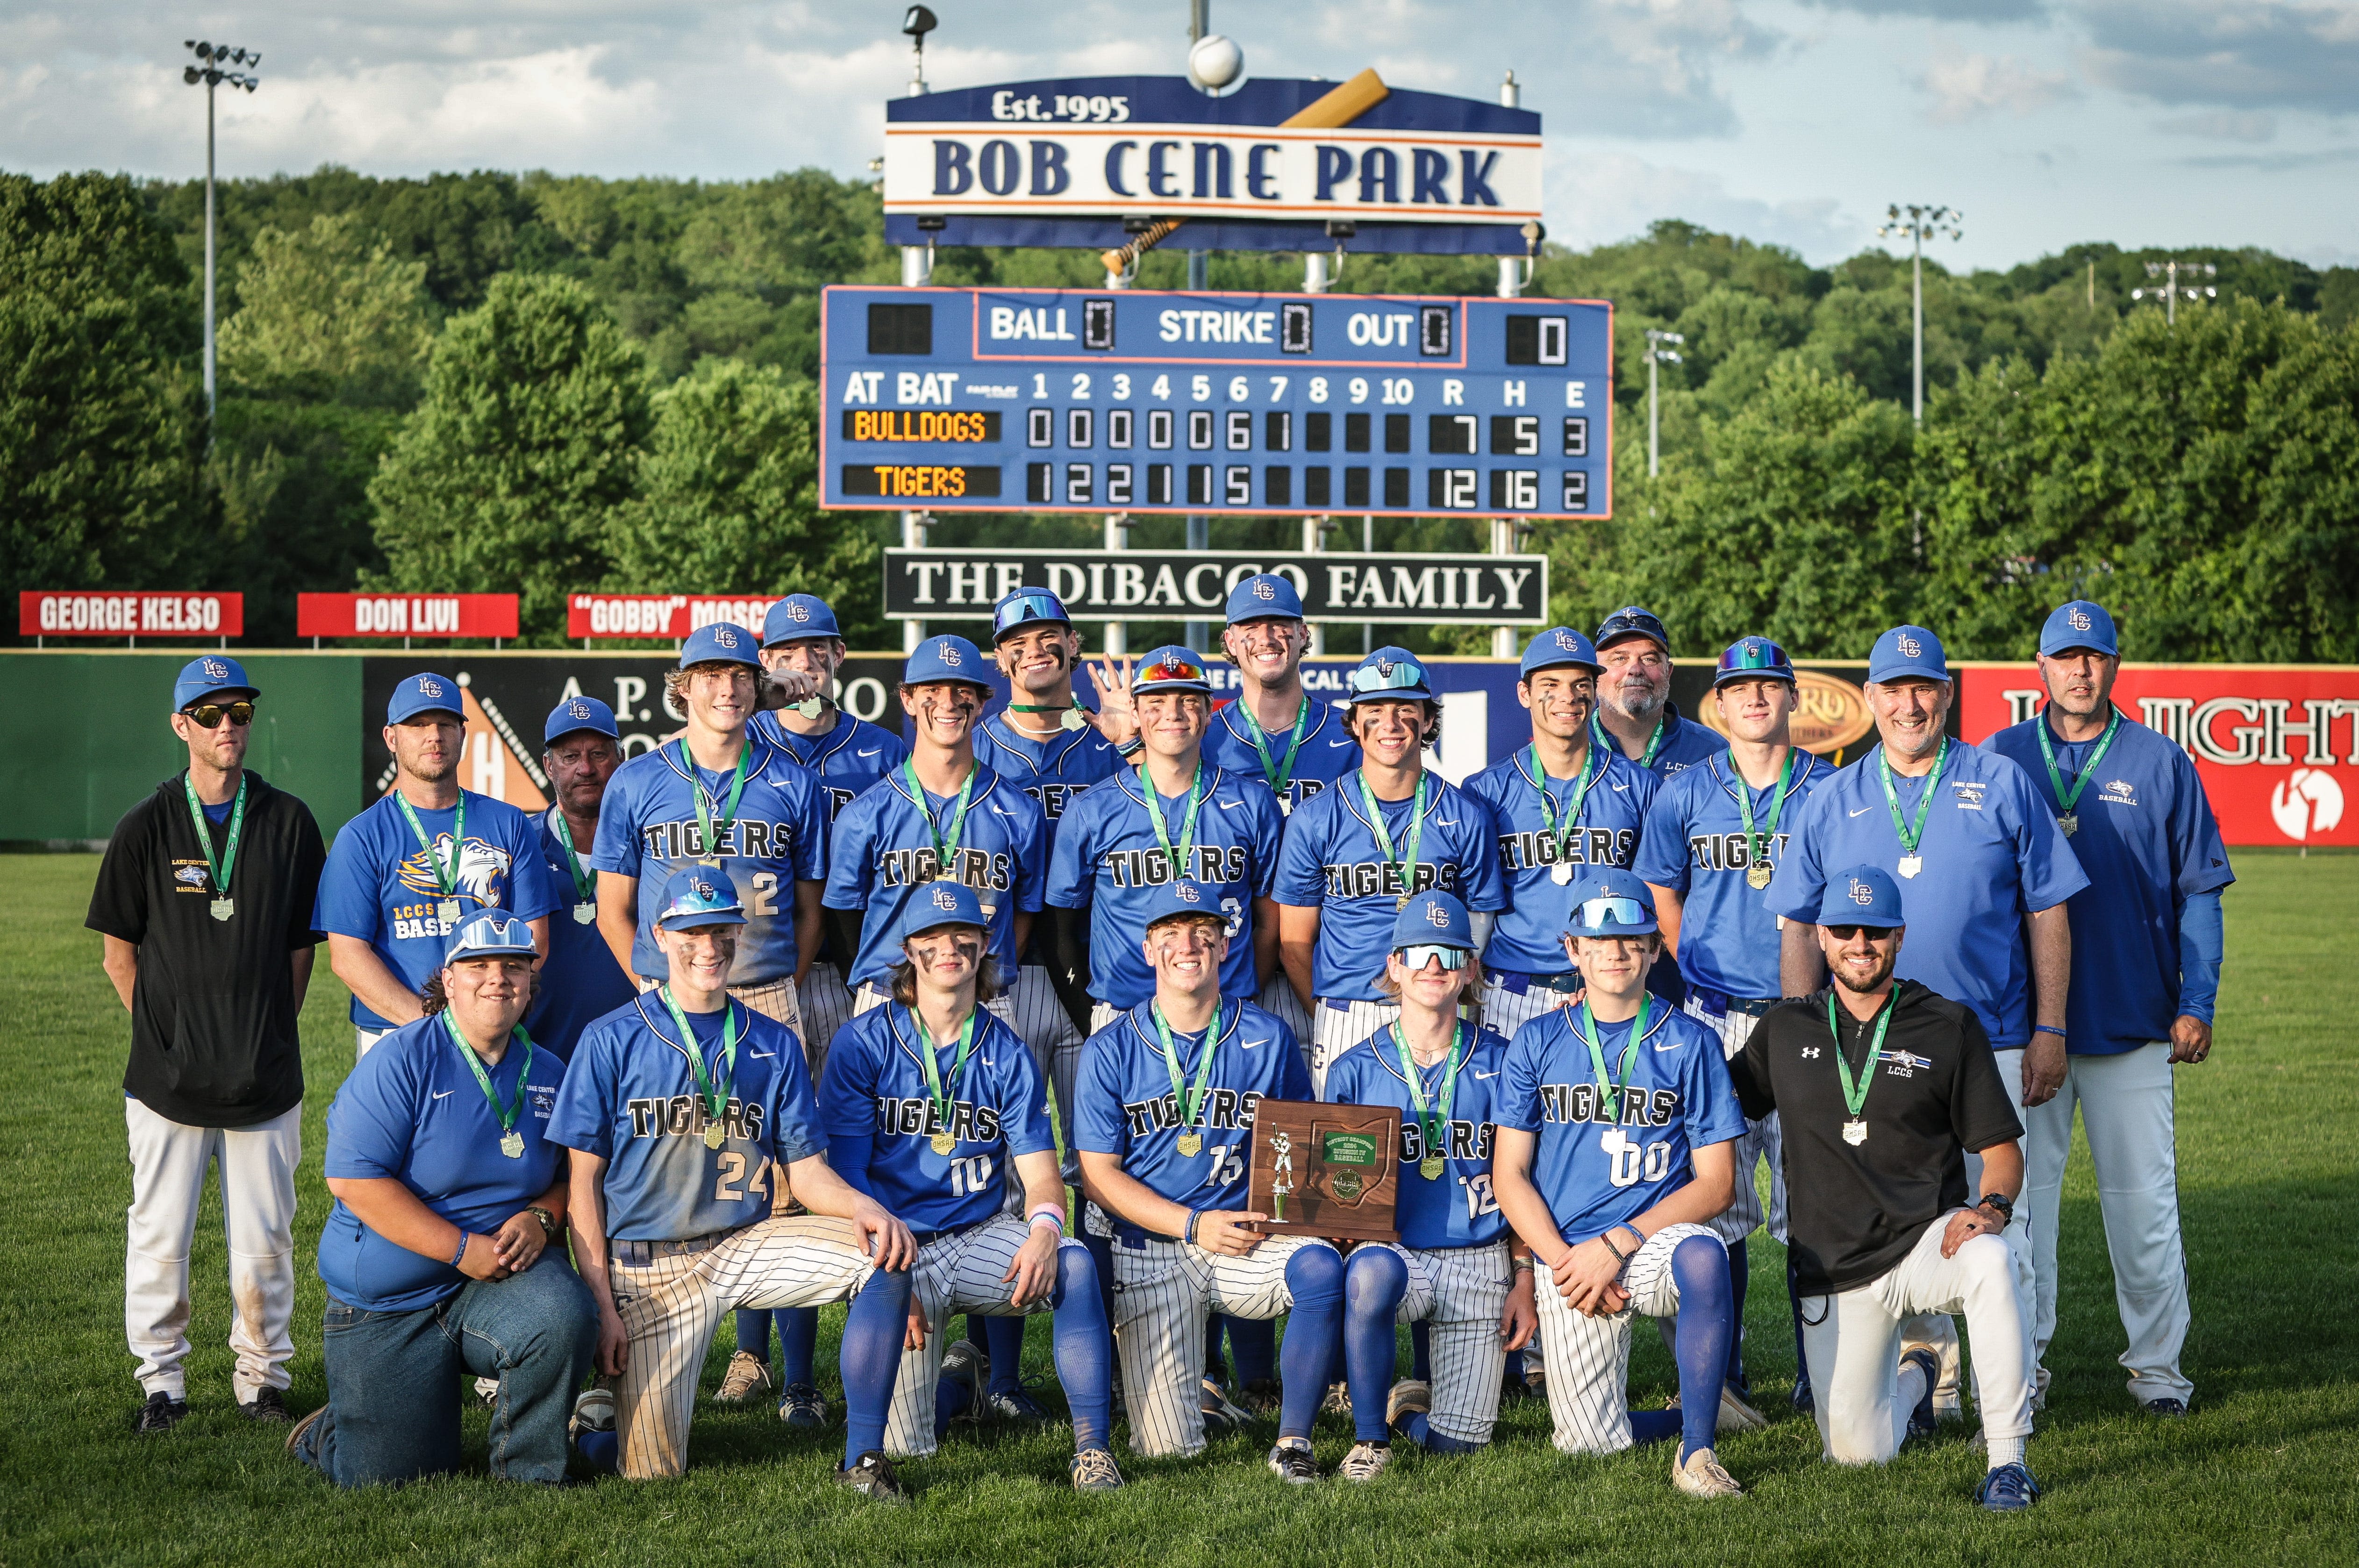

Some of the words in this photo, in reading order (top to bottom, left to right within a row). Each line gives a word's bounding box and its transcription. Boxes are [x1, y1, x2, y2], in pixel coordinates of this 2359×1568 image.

[992, 90, 1053, 121] Est.
[1054, 95, 1130, 122] 1995
[932, 140, 1070, 196] BOB
[1106, 141, 1281, 200] CENE
[1315, 144, 1504, 207] PARK
[990, 307, 1076, 341] BALL
[1159, 309, 1275, 344] STRIKE
[1347, 313, 1414, 347] OUT
[1538, 317, 1567, 365] 0
[844, 372, 885, 404] AT
[897, 372, 959, 405] BAT
[1033, 374, 1048, 399] 1
[1072, 374, 1091, 399] 2
[1112, 374, 1131, 400] 3
[1151, 375, 1171, 400] 4
[1192, 375, 1211, 402] 5
[1229, 377, 1249, 402] 6
[1269, 377, 1288, 402] 7
[1308, 377, 1329, 404] 8
[1349, 378, 1369, 404] 9
[1381, 378, 1414, 405] 10
[1443, 379, 1465, 406] R
[1503, 380, 1526, 407] H
[1566, 381, 1586, 408] E
[854, 411, 986, 442] BULLDOGS
[1029, 410, 1051, 448] 0
[1069, 410, 1092, 448] 0
[1109, 410, 1132, 449] 0
[1150, 410, 1172, 449] 0
[1190, 411, 1212, 449] 0
[1228, 413, 1250, 450] 6
[1282, 413, 1290, 451] 1
[1453, 416, 1477, 454] 7
[1515, 417, 1537, 455] 5
[1565, 418, 1587, 456] 3
[874, 466, 966, 497] TIGERS
[1043, 464, 1051, 502] 1
[1068, 465, 1092, 503] 2
[1108, 465, 1131, 503] 2
[1163, 466, 1171, 503] 1
[1203, 466, 1211, 504] 1
[1226, 467, 1250, 505] 5
[1444, 469, 1476, 508] 12
[1505, 471, 1537, 509] 16
[1564, 472, 1586, 509] 2
[906, 561, 1023, 604] THE
[1326, 565, 1532, 609] FAMILY
[40, 596, 137, 631] GEORGE
[142, 597, 221, 632] KELSO
[355, 598, 407, 632] DON
[411, 599, 459, 632] LIVI
[2098, 794, 2138, 806] BASEBALL
[644, 818, 792, 860] TIGERS
[1498, 827, 1634, 870] TIGERS
[752, 871, 779, 916] 2
[1323, 862, 1458, 898] TIGERS
[393, 903, 434, 920] LCCS
[394, 917, 460, 940] BASE
[1887, 1066, 1913, 1078] LCCS
[626, 1093, 765, 1142] TIGERS
[1539, 1083, 1678, 1127] TIGERS
[1179, 1140, 1201, 1150] OHSAA
[1401, 1120, 1494, 1164] GERS
[715, 1151, 771, 1203] 24
[950, 1154, 993, 1197] 10
[1205, 1143, 1244, 1187] 15
[1421, 1163, 1443, 1172] OHSAA
[1608, 1140, 1672, 1188] 00
[1458, 1174, 1499, 1220] 12
